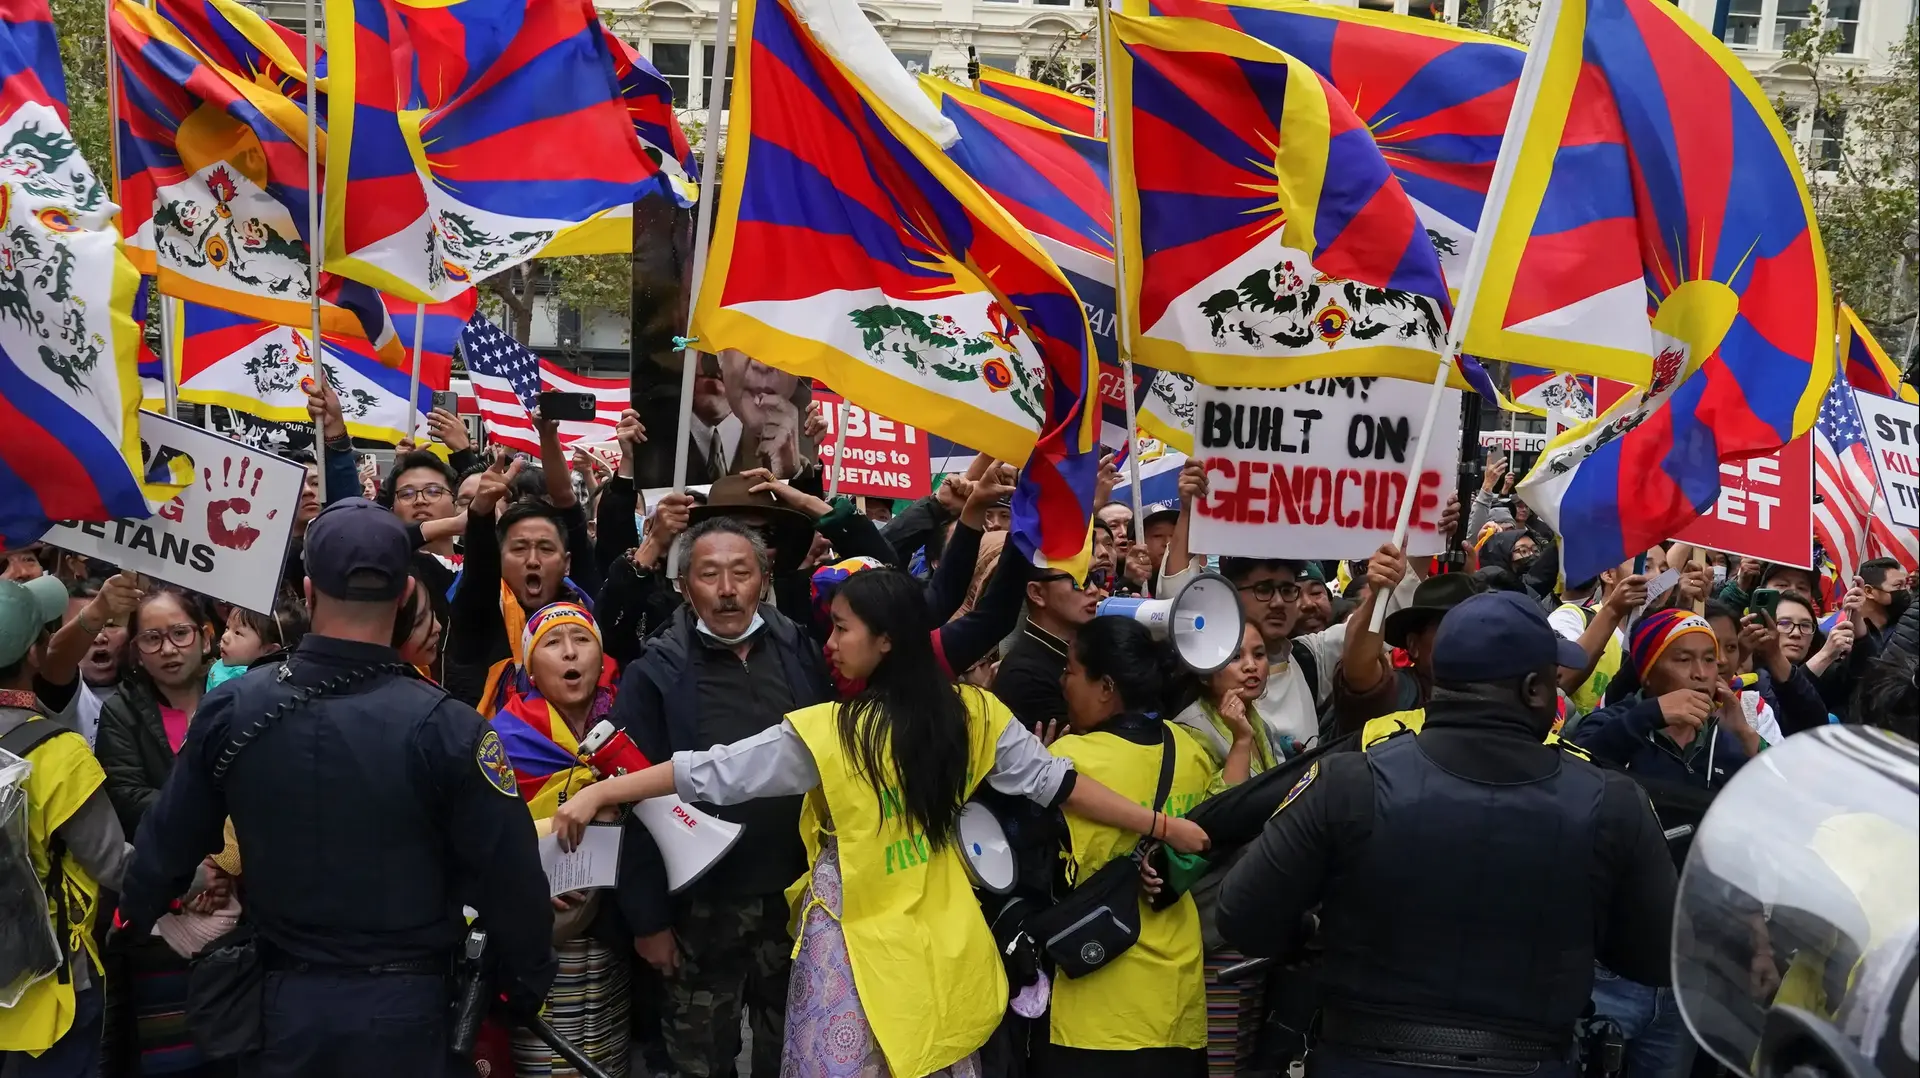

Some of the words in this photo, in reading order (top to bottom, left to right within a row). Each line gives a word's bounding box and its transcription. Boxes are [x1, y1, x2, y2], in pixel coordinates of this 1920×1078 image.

[1202, 401, 1323, 454] BUILT
[1347, 414, 1410, 463] ON
[1874, 413, 1919, 446] ST
[890, 450, 910, 465] to
[1881, 449, 1919, 477] KIL
[824, 465, 911, 488] IBETANS
[1196, 457, 1442, 530] GENOCIDE
[1150, 612, 1164, 621] PYLE
[672, 805, 698, 828] PYLE
